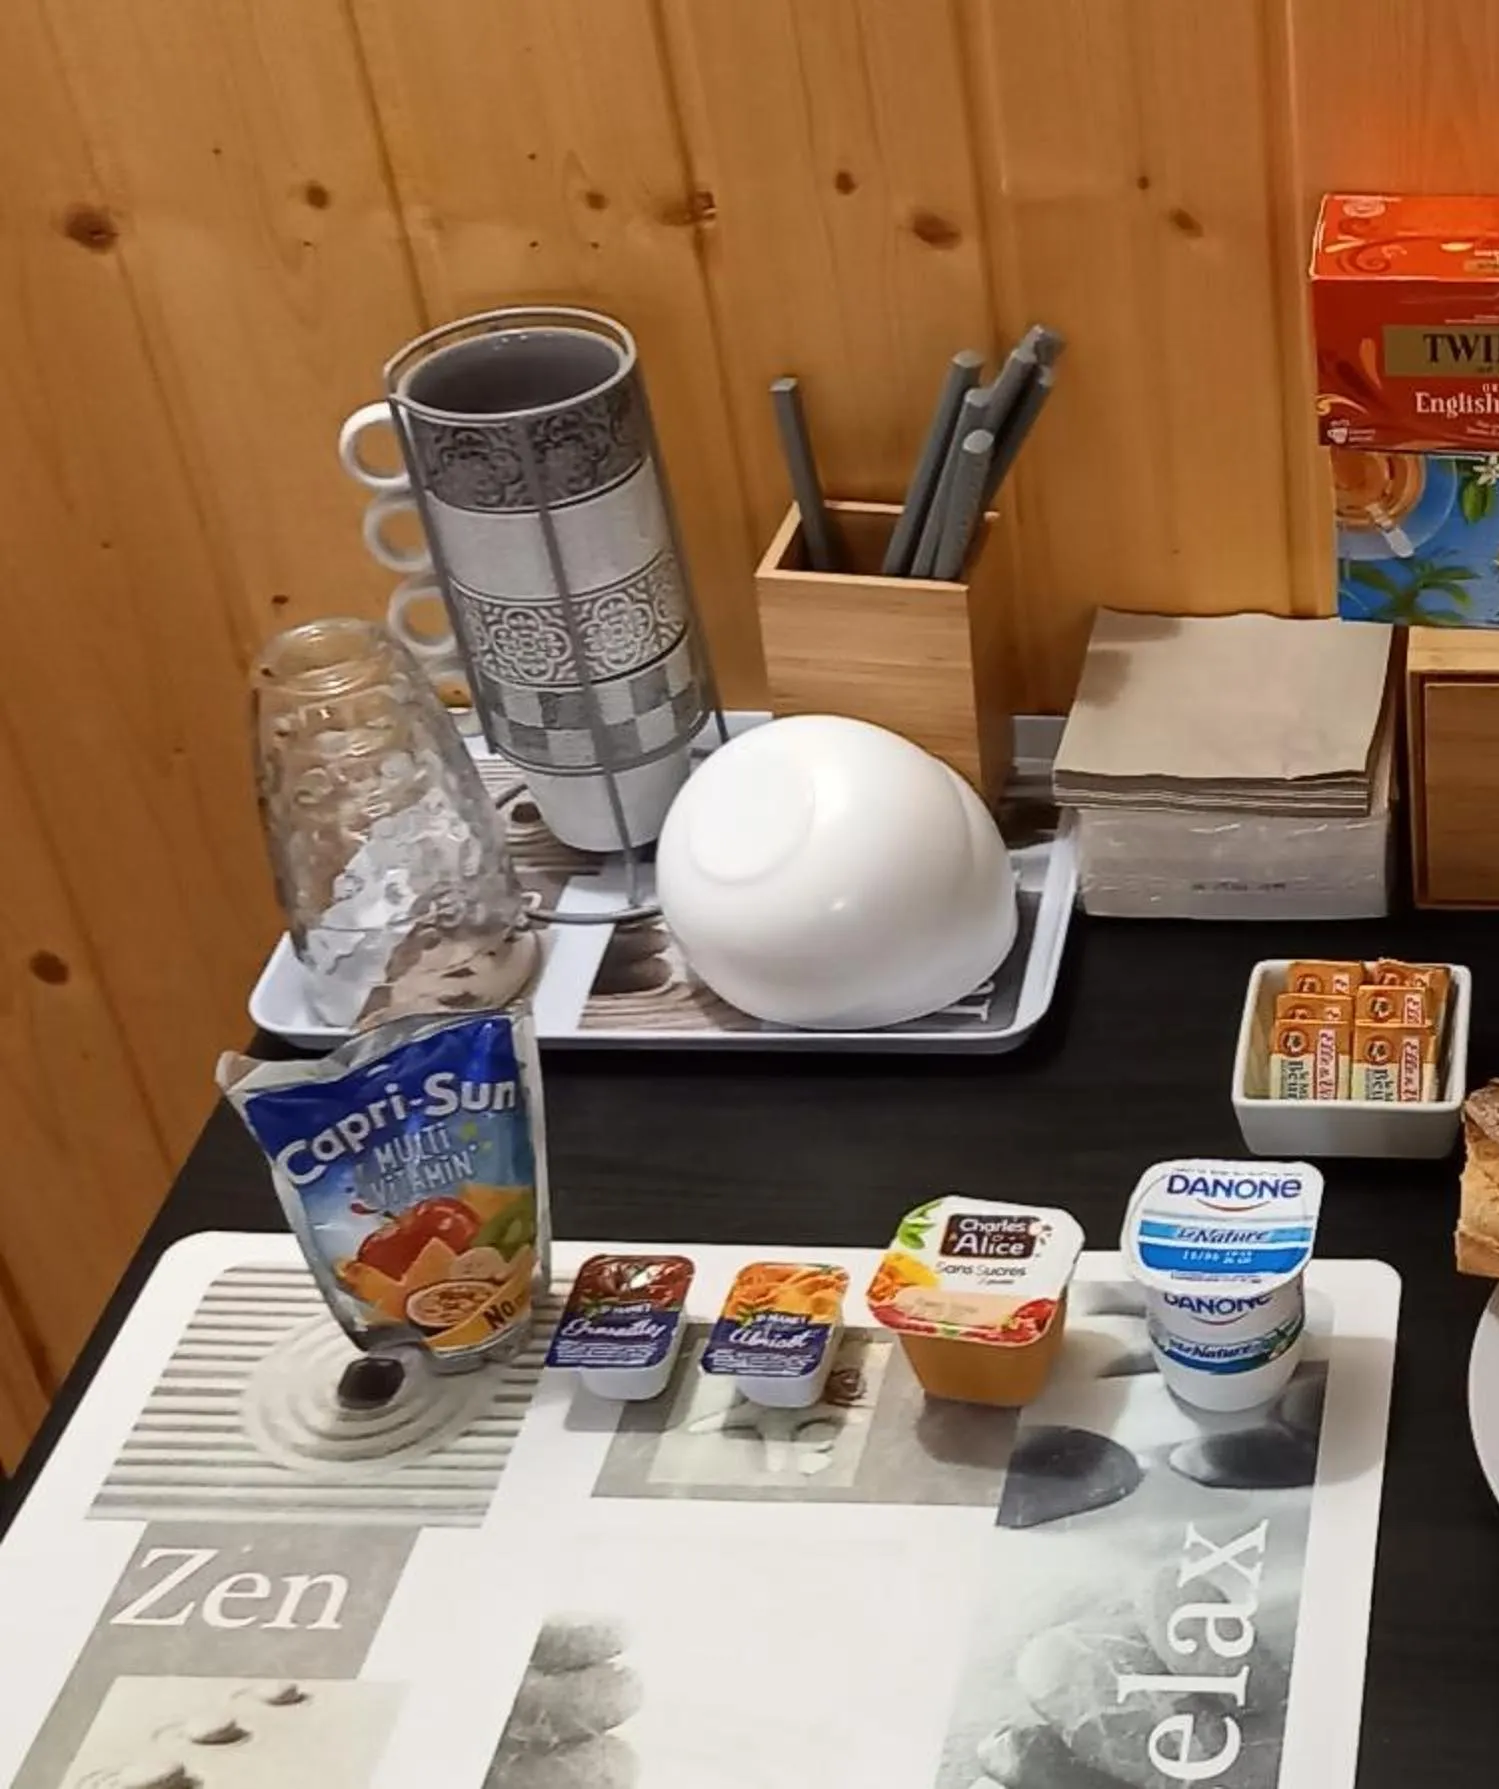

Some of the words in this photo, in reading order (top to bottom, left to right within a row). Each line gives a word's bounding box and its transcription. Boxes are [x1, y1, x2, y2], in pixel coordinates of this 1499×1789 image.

[1415, 391, 1499, 418] English
[275, 1071, 516, 1186] Capri-Sun
[952, 1233, 1025, 1256] Alice
[959, 1218, 1027, 1233] Charles
[109, 1547, 349, 1630] Zen
[1115, 1518, 1270, 1782] elax
